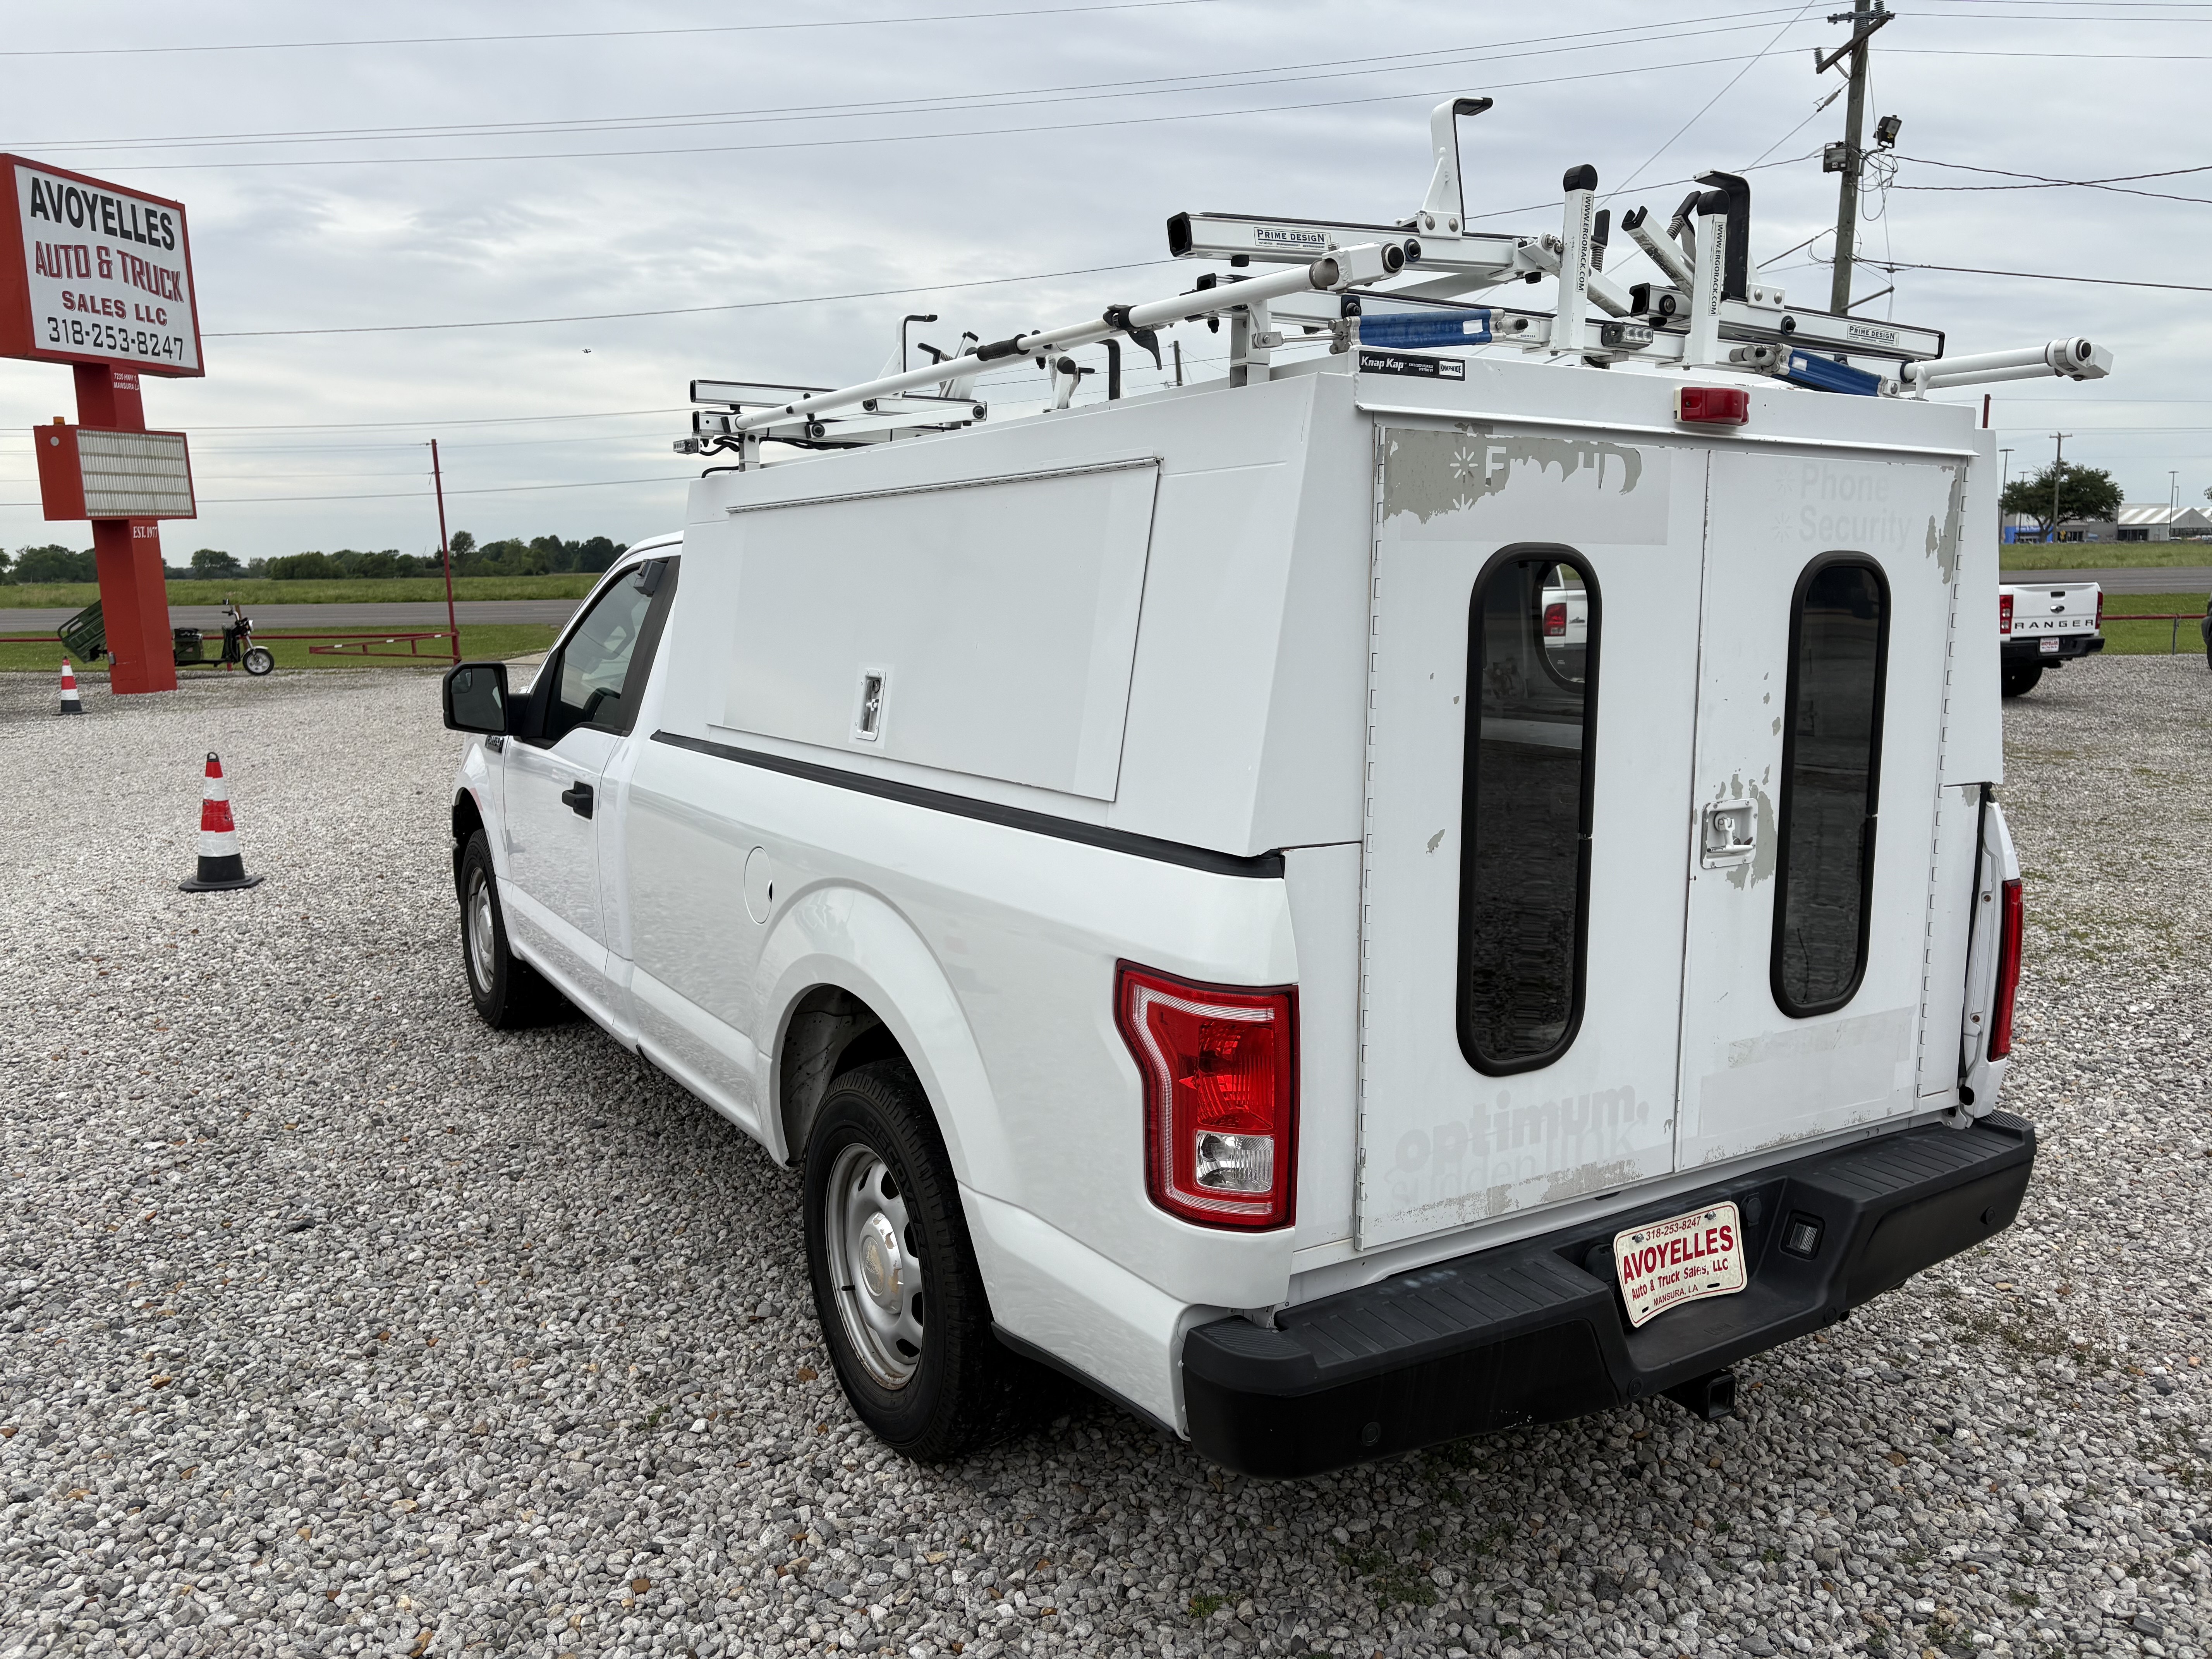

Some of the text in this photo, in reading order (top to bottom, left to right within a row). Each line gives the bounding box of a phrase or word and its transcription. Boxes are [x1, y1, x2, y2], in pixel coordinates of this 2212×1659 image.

[31, 177, 175, 251] AVOYELLES
[1257, 229, 1325, 242] PRIME DESIGN
[1576, 196, 1591, 291] WWW.ERGORACK.COM
[36, 241, 184, 303] AUTO & TRUCK
[1710, 224, 1724, 315] WWW.ERGORACK.COM
[62, 290, 167, 326] SALES LLC
[47, 317, 183, 361] 318-253-8247
[1849, 326, 1869, 335] PRIME
[1871, 331, 1895, 340] DESIGN
[1361, 356, 1404, 371] Knap Kap
[1440, 363, 1462, 373] KNAPHEIDE
[1800, 462, 1889, 502] Phone
[133, 526, 158, 538] EST. 1977
[1798, 505, 1912, 552] Security
[2015, 619, 2093, 629] RANGER
[1646, 1216, 1702, 1241] 318-253-8247
[1623, 1225, 1734, 1285] AVOYELLES
[1632, 1258, 1729, 1301] Auto & Truck Sales, LLC
[1653, 1284, 1698, 1307] MANSURA, LA
